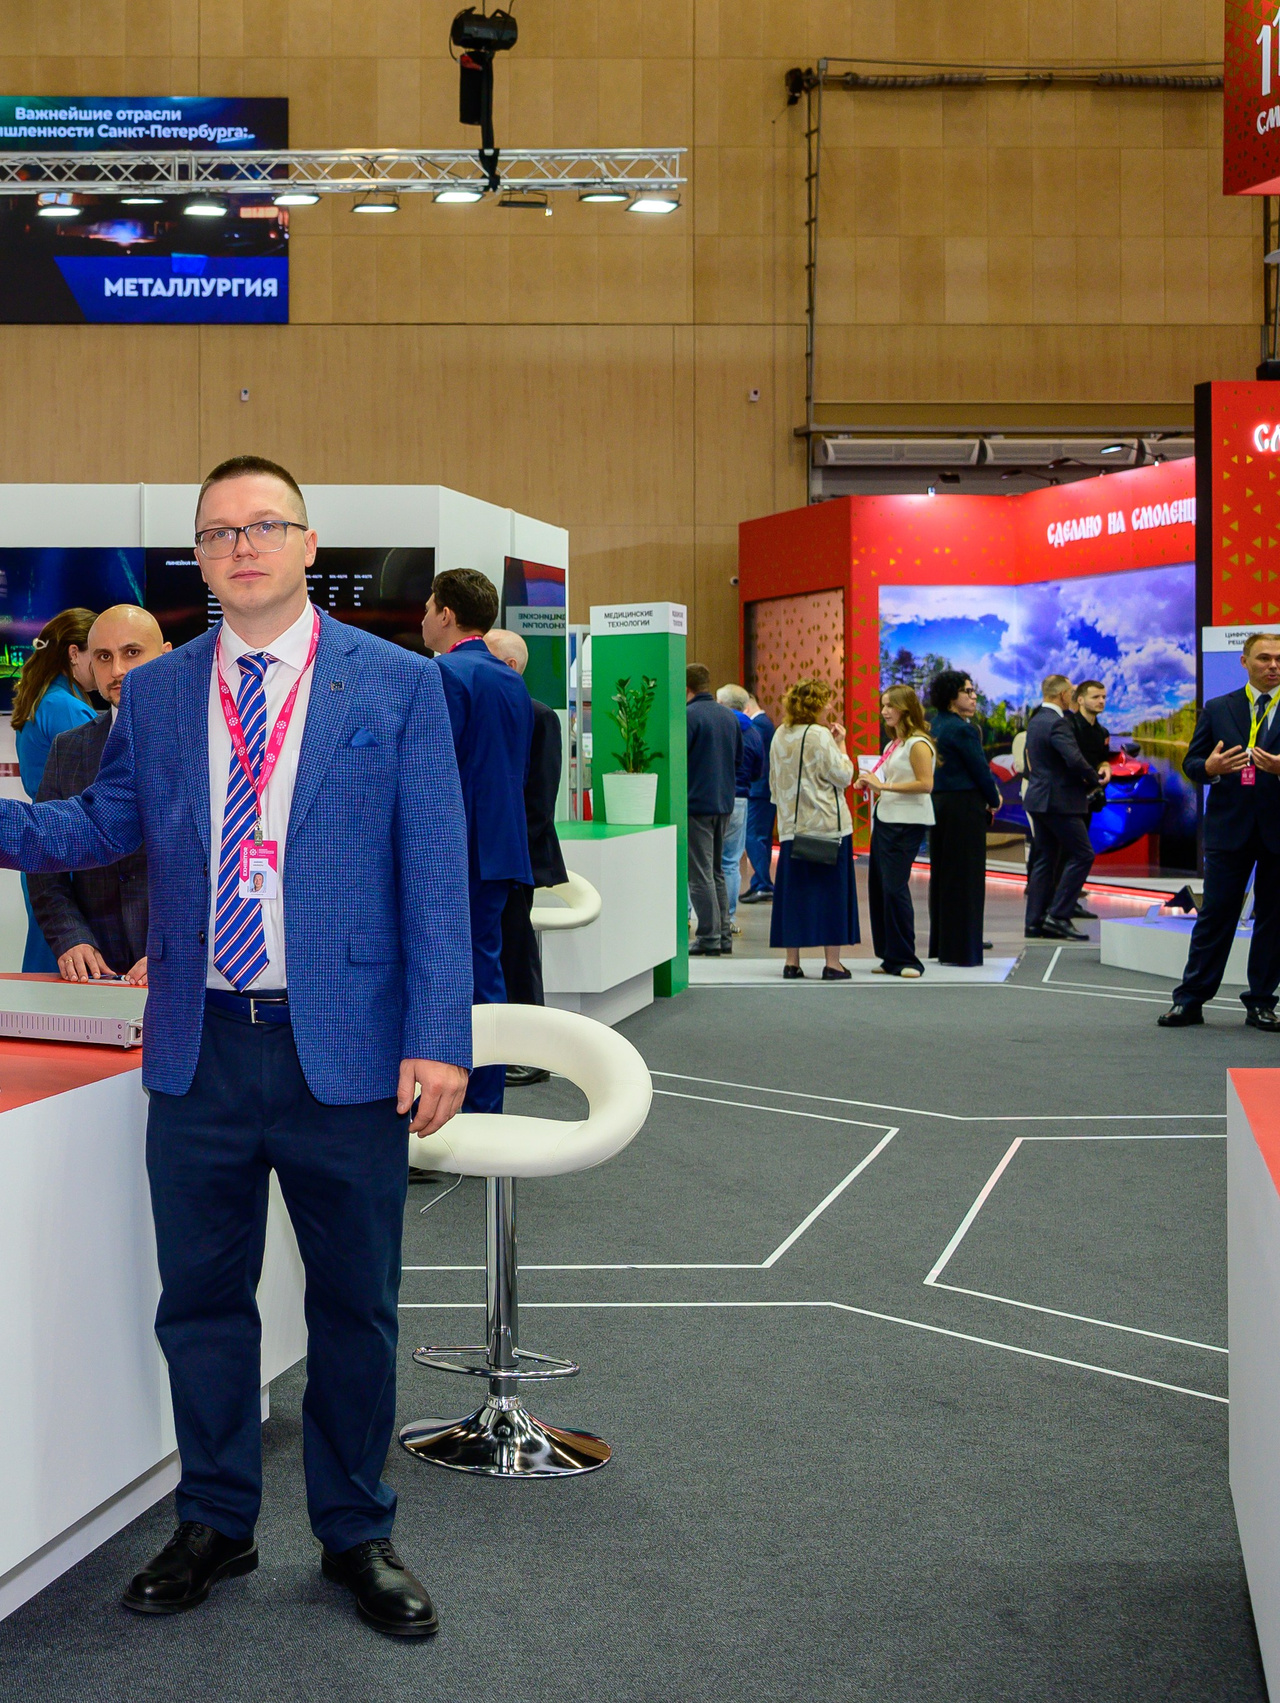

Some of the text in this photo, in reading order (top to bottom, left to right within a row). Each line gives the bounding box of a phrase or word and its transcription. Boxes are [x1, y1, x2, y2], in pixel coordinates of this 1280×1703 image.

[15, 106, 182, 123] Важнейшие отрасли
[104, 277, 278, 297] МЕТАЛЛУРГИЯ
[1047, 514, 1102, 548] СДЕЛАНО
[1107, 510, 1126, 535] НА
[604, 610, 653, 620] МЕДИЦИНСКИЕ
[608, 619, 650, 628] ТЕХНОЛОГИИ
